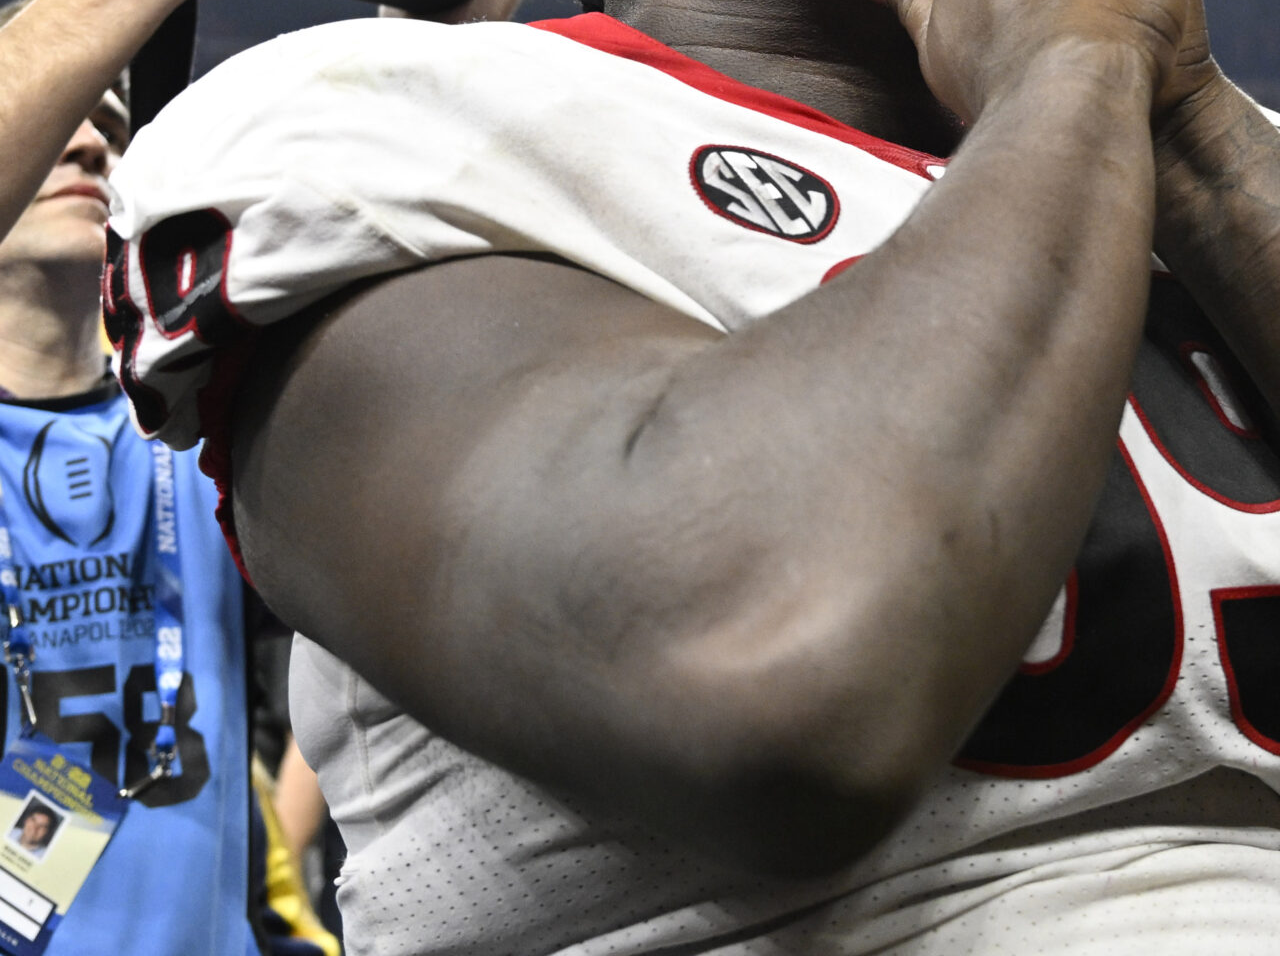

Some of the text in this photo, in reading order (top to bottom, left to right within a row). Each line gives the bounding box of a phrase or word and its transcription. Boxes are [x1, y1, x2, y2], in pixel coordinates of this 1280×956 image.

[702, 151, 828, 236] SEC
[152, 443, 177, 554] NATIONAL
[157, 627, 182, 660] 22
